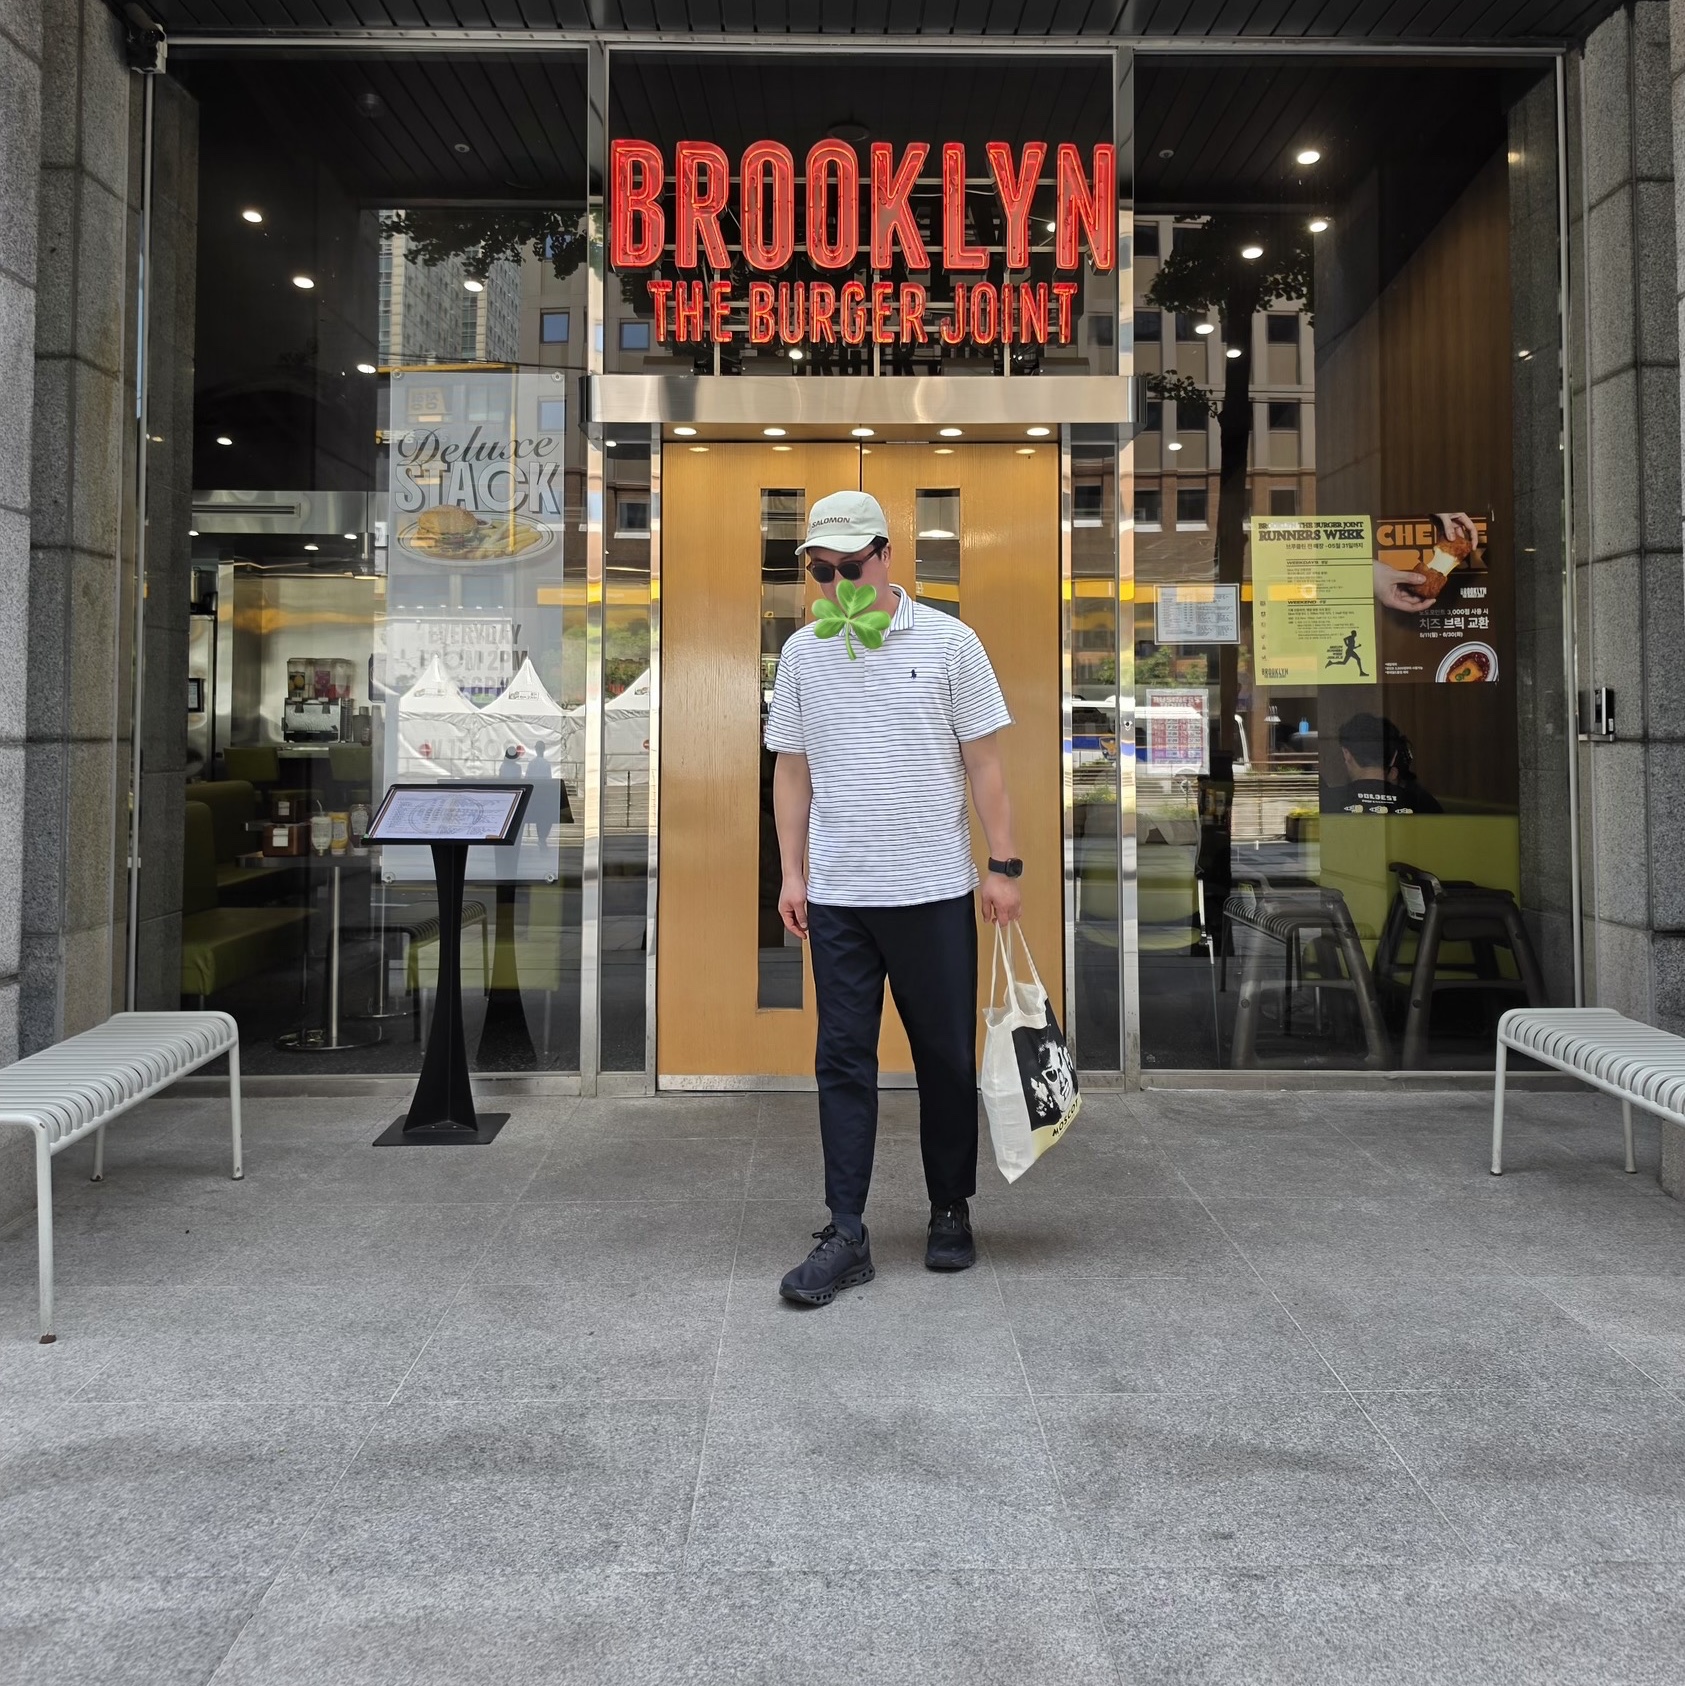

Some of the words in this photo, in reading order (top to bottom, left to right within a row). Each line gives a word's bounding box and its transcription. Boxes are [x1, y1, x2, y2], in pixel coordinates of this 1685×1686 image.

[610, 139, 1117, 272] BROOKLYN
[647, 280, 732, 343] THE
[748, 280, 929, 345] BURGER
[940, 281, 1078, 345] JOINT
[397, 425, 560, 464] Deluxe
[394, 460, 561, 514] STACK
[811, 517, 850, 528] SALOMON
[1298, 521, 1313, 529] THE
[1314, 521, 1343, 529] BURGER
[1343, 521, 1364, 529] JOINT
[1258, 529, 1321, 542] RUNNERS
[1323, 529, 1365, 540] WEEK
[1419, 617, 1441, 630] 치즈
[1443, 616, 1465, 630] 브릭
[1467, 616, 1490, 629] 교환
[1261, 667, 1289, 675] BROOKLYN
[1052, 1099, 1079, 1136] MOSCOT
